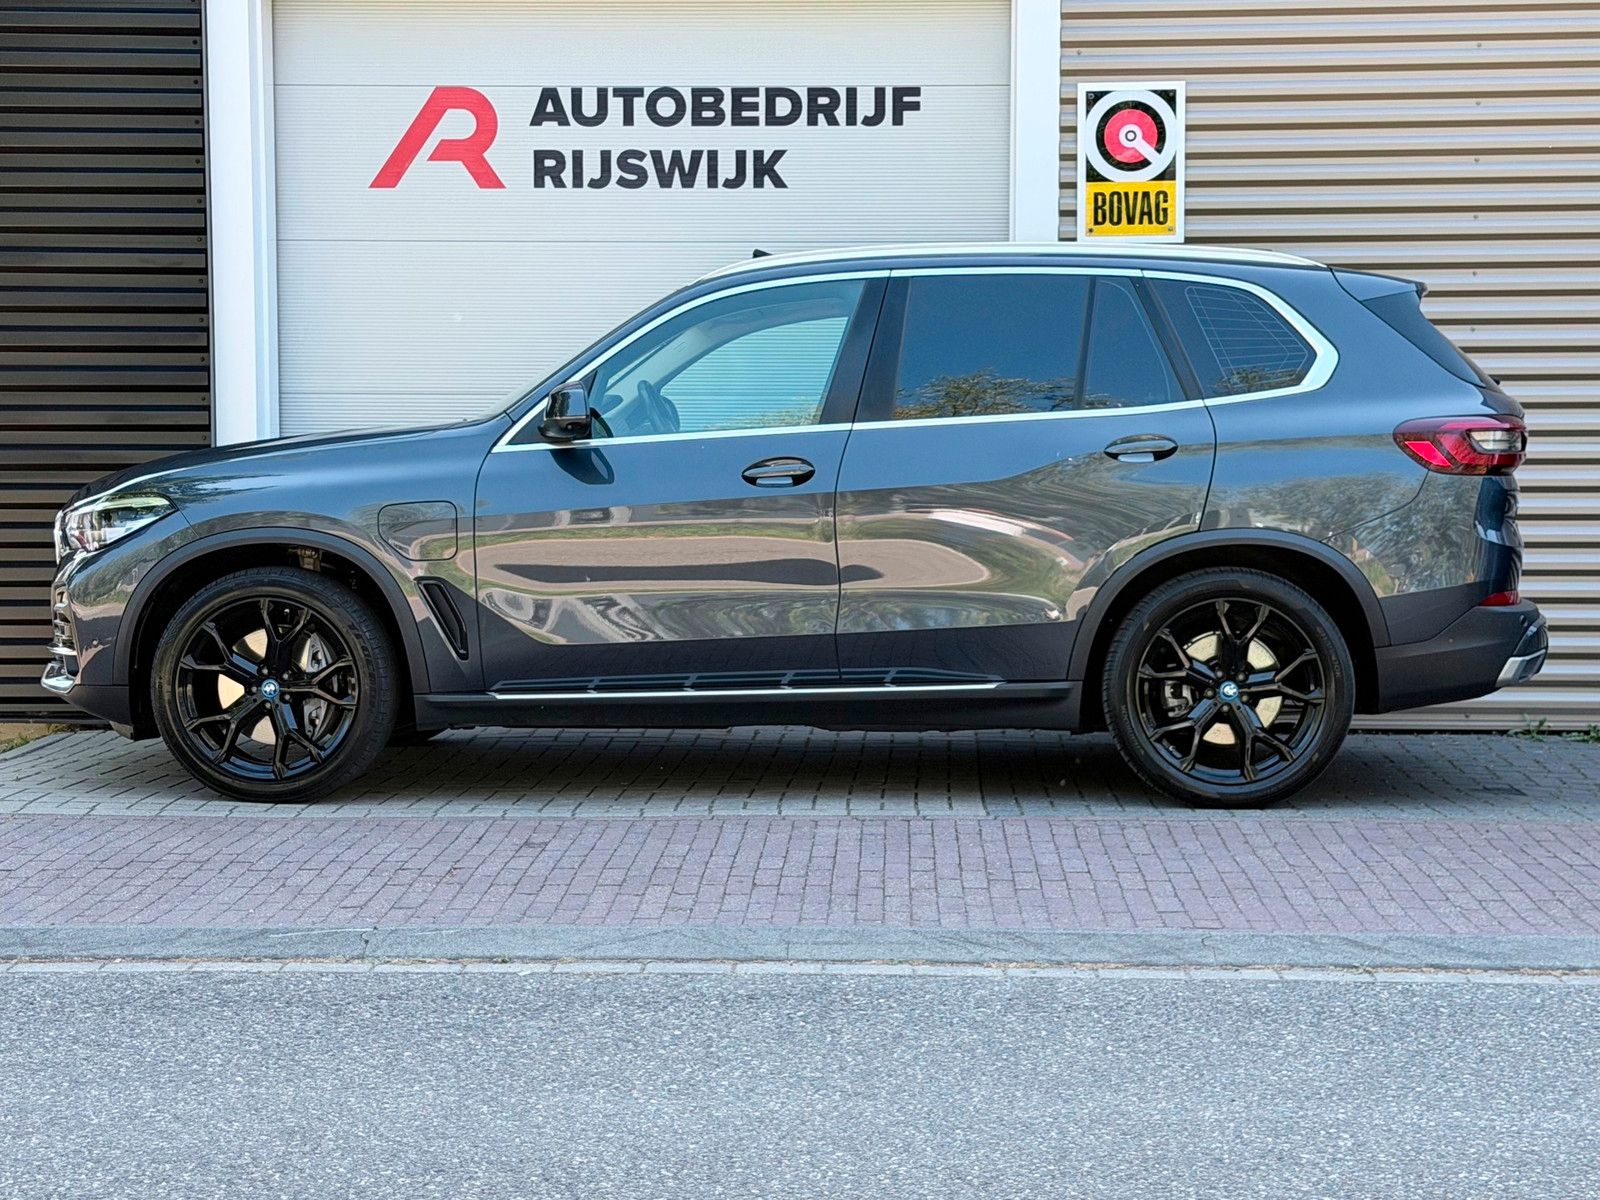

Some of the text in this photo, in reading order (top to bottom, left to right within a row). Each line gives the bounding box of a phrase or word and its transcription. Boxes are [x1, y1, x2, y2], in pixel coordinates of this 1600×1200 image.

[529, 86, 921, 127] AUTOBEDRIJF
[533, 149, 788, 189] RIJSWIJK
[1093, 190, 1169, 226] BOVAG
